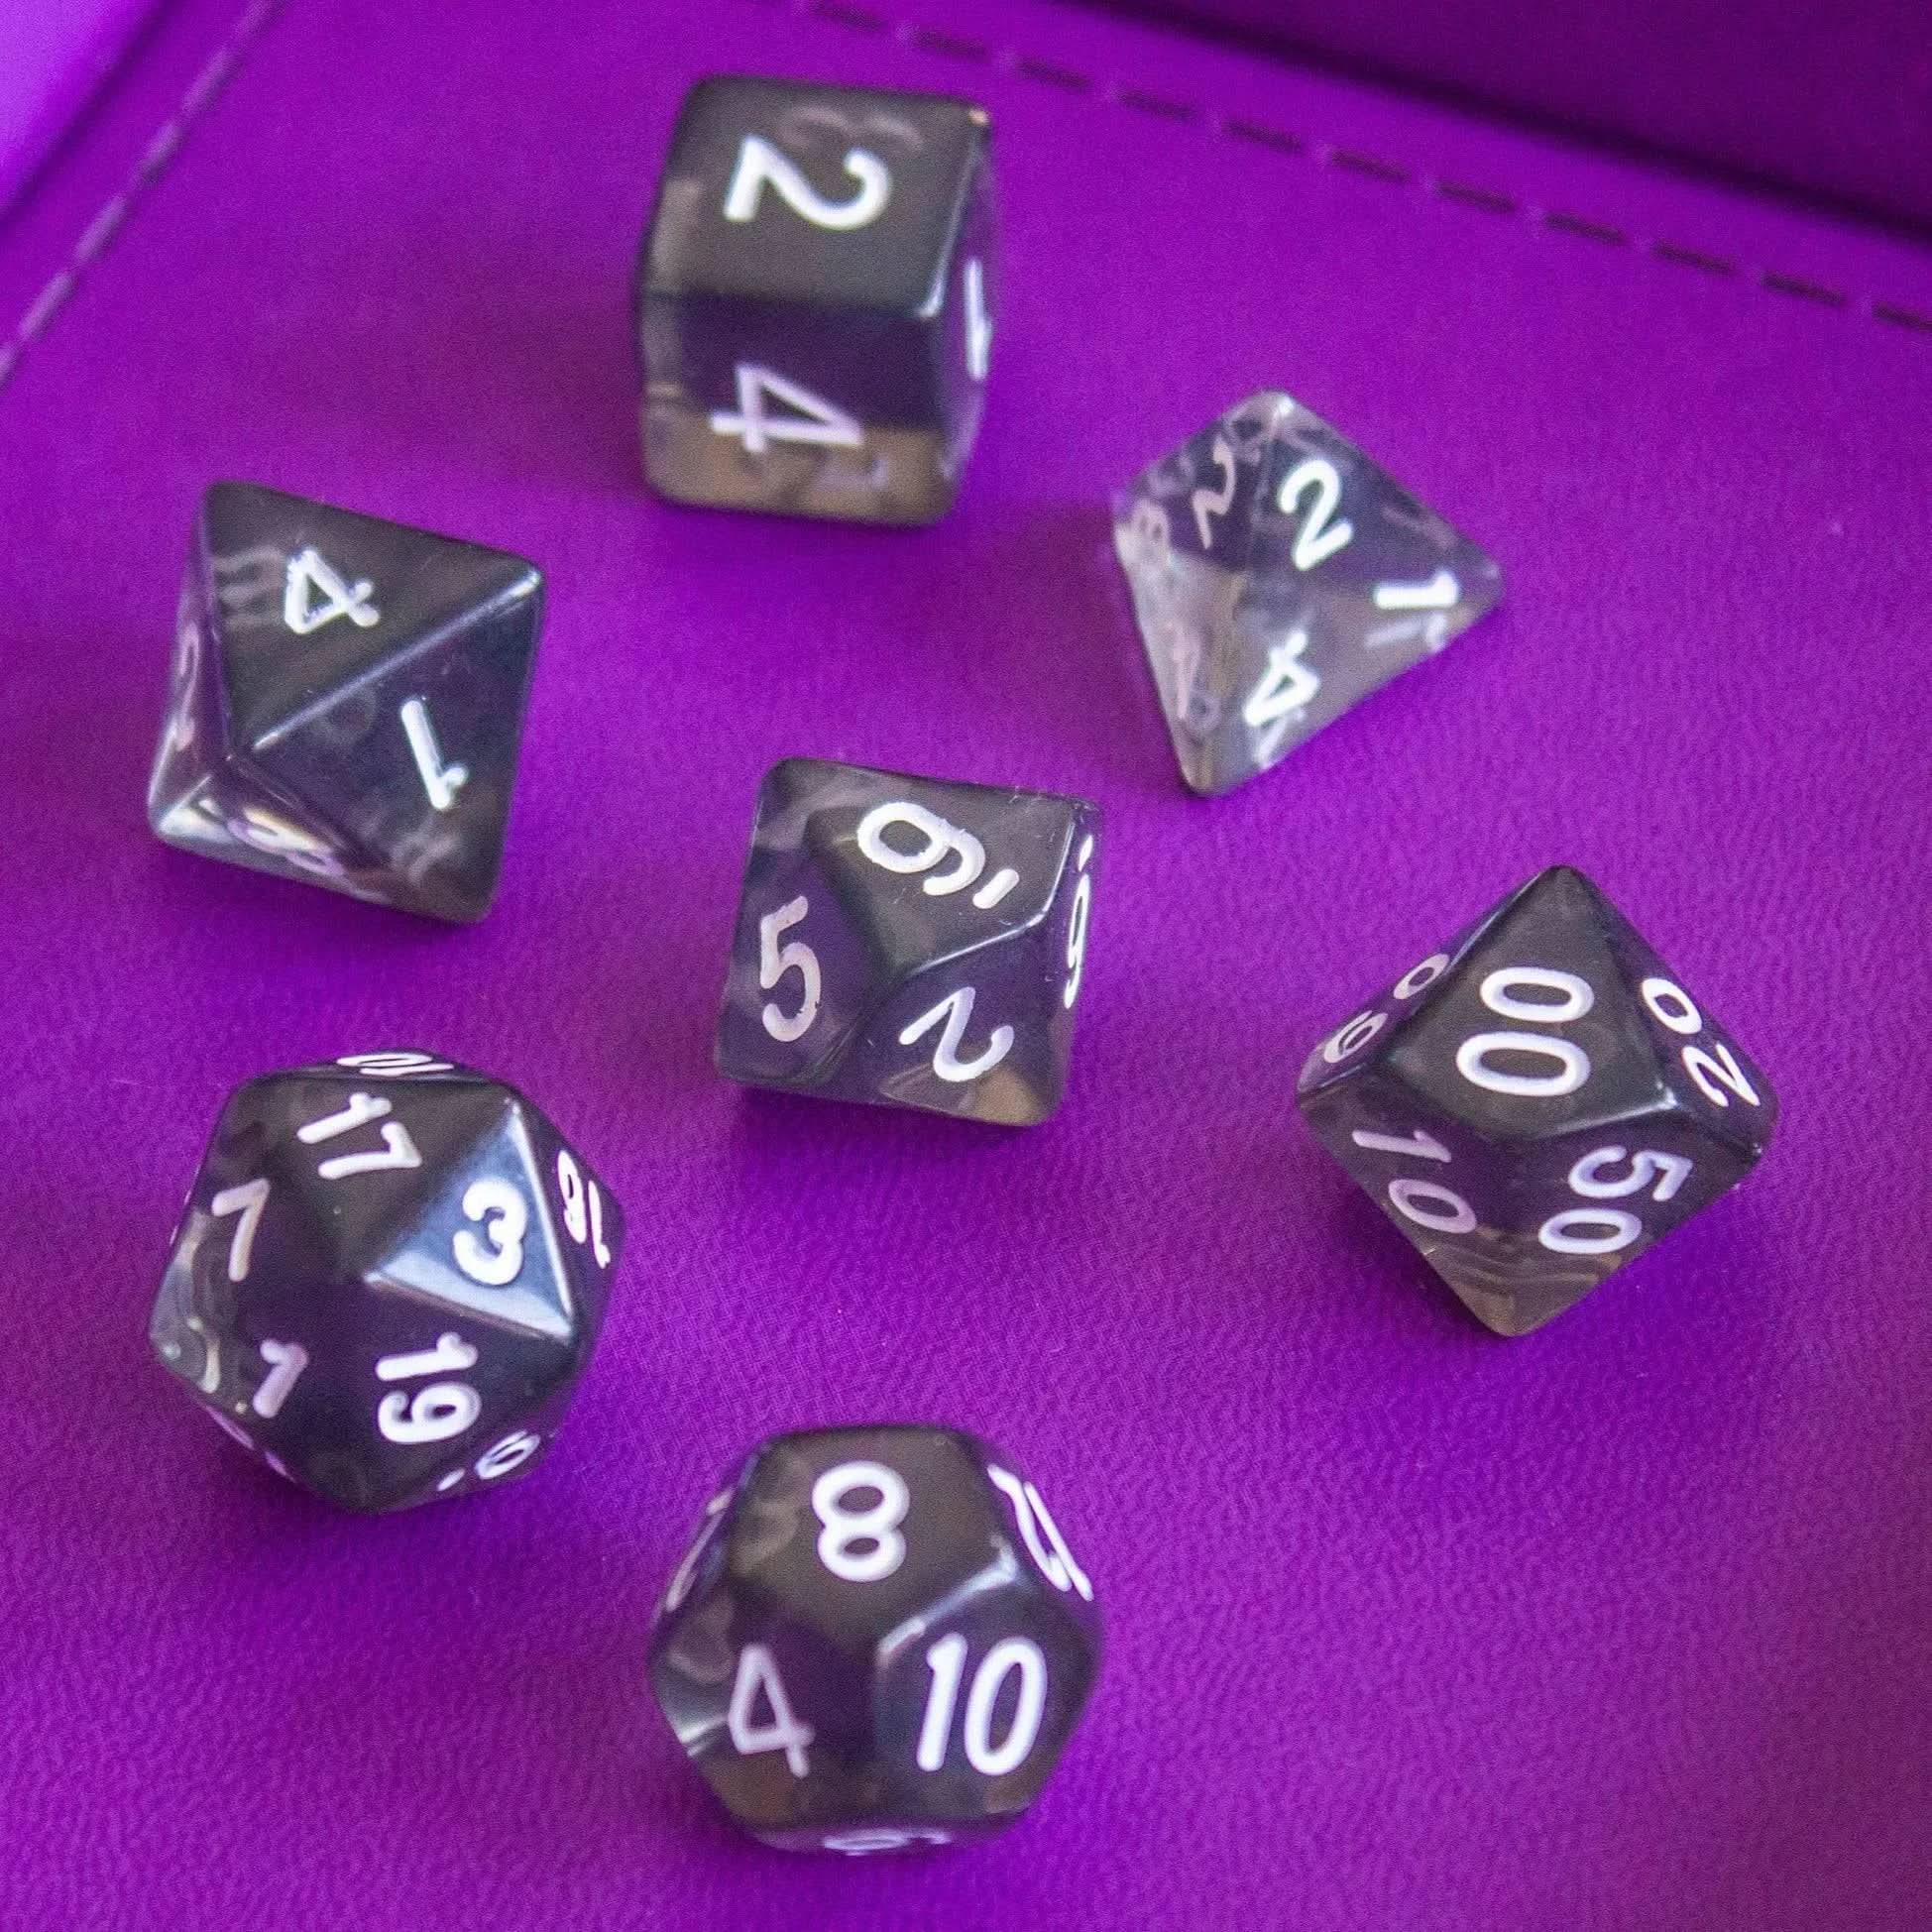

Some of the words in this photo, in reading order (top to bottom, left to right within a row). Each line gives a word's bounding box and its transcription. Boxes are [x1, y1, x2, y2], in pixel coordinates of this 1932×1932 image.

[724, 135, 889, 231] 2
[709, 362, 864, 453] 4
[1278, 456, 1354, 570] 2
[284, 548, 381, 634] 4
[1373, 568, 1460, 610] 1
[1242, 627, 1320, 727] 4
[399, 698, 469, 810] 1
[760, 895, 822, 1042] 5
[899, 986, 1014, 1081] 2
[1456, 966, 1594, 1096] 00
[1642, 977, 1760, 1107] 20
[297, 1092, 422, 1180] 17
[1352, 1130, 1477, 1234] 10
[211, 1179, 270, 1282] 7
[453, 1178, 526, 1286] 3
[1538, 1146, 1693, 1255] 50
[375, 1331, 481, 1444] 19
[812, 1460, 910, 1582] 8
[728, 1643, 815, 1778] 4
[917, 1633, 1047, 1775] 10
